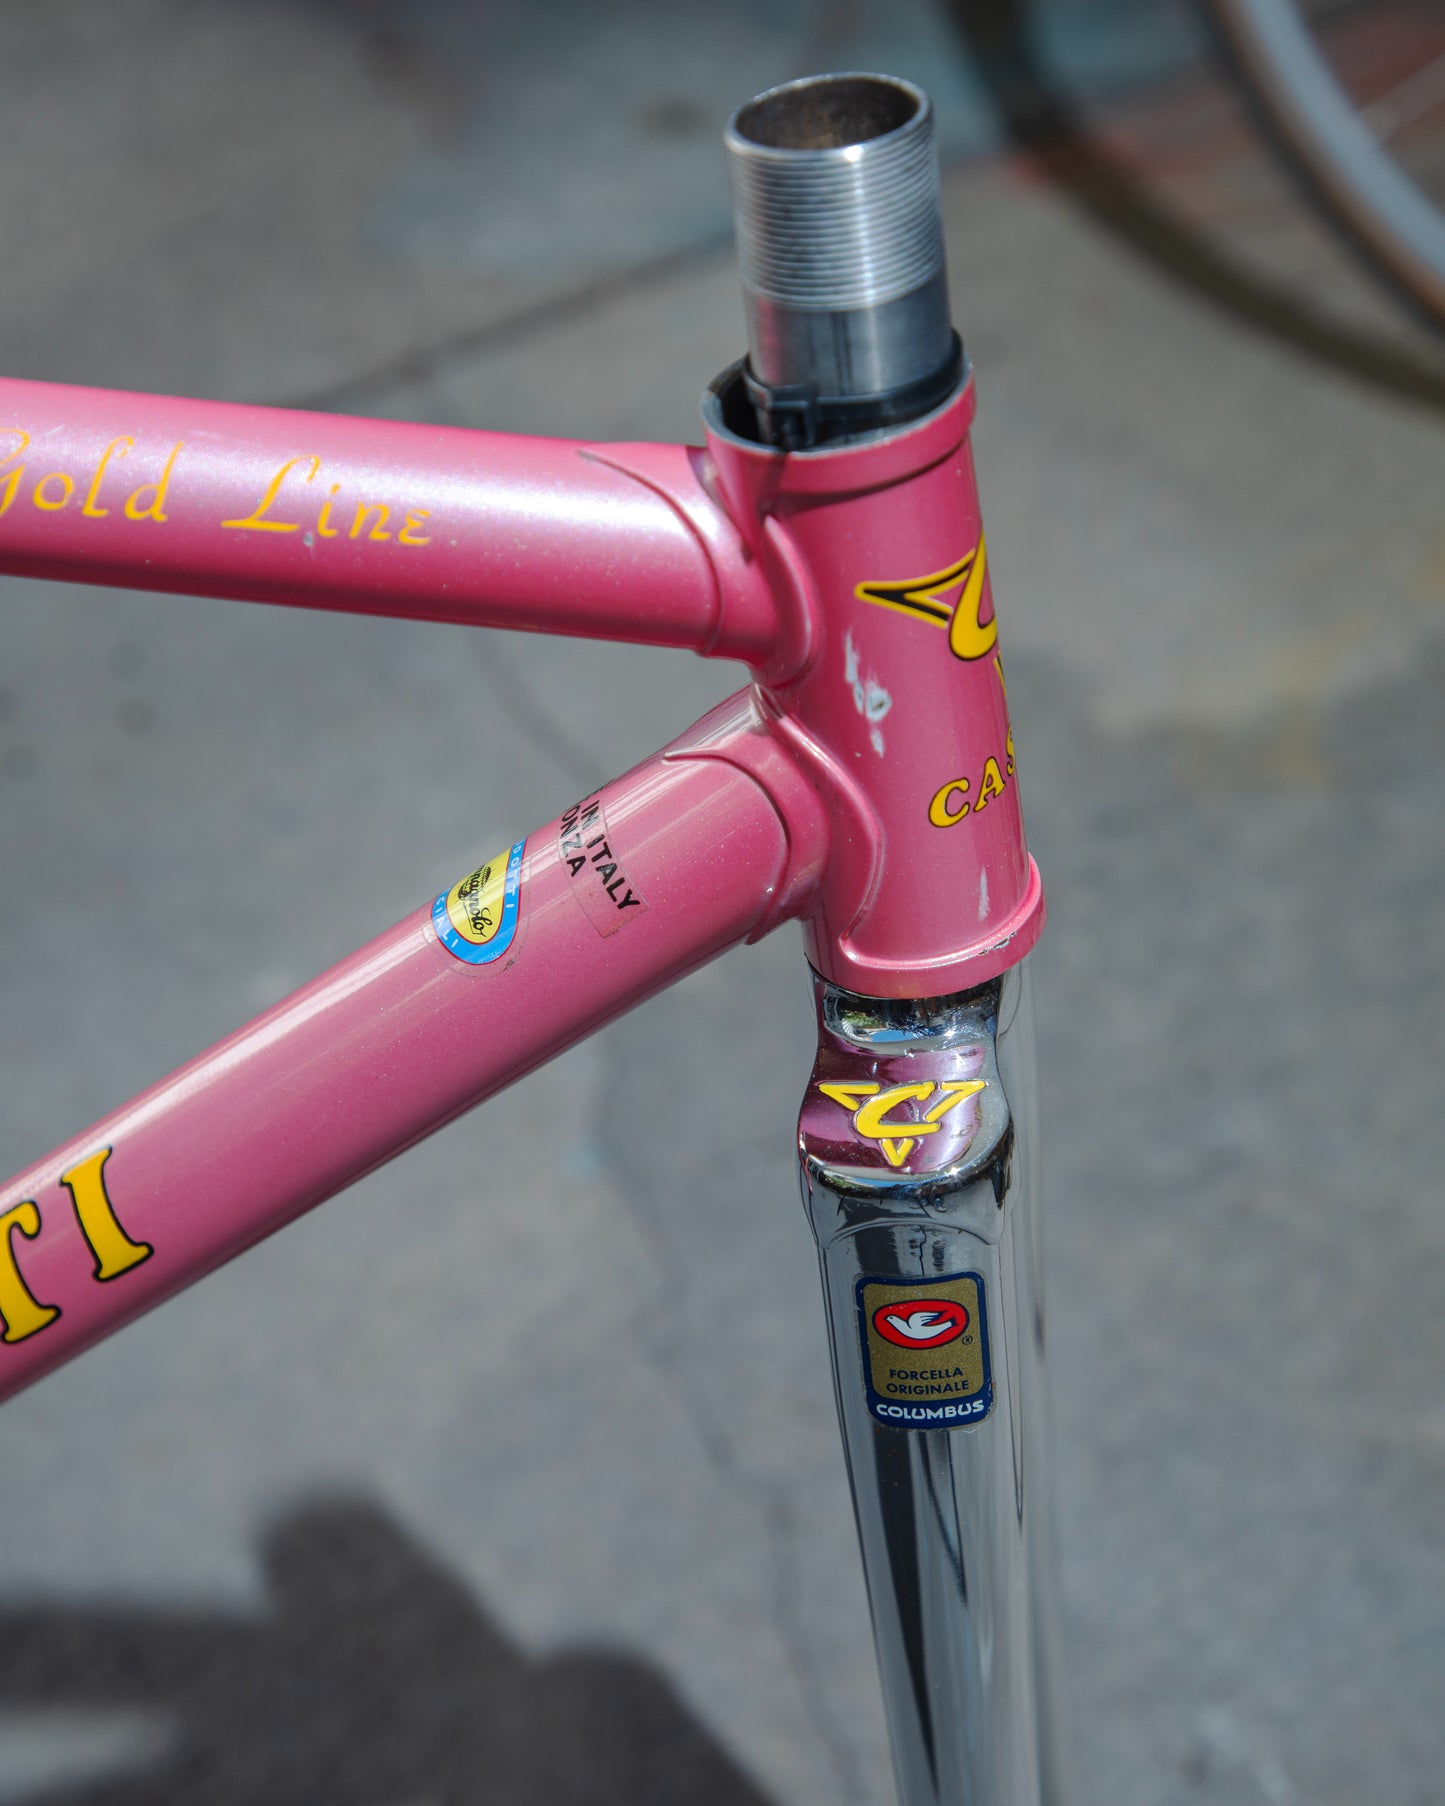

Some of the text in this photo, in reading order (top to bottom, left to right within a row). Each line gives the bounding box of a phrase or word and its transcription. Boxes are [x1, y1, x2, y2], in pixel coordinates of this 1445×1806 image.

[221, 454, 431, 546] Line
[580, 799, 642, 911] IN ITALY
[889, 1366, 964, 1381] FORCELLA
[886, 1379, 970, 1396] ORIGINALE
[875, 1399, 985, 1421] COLUMBUS
